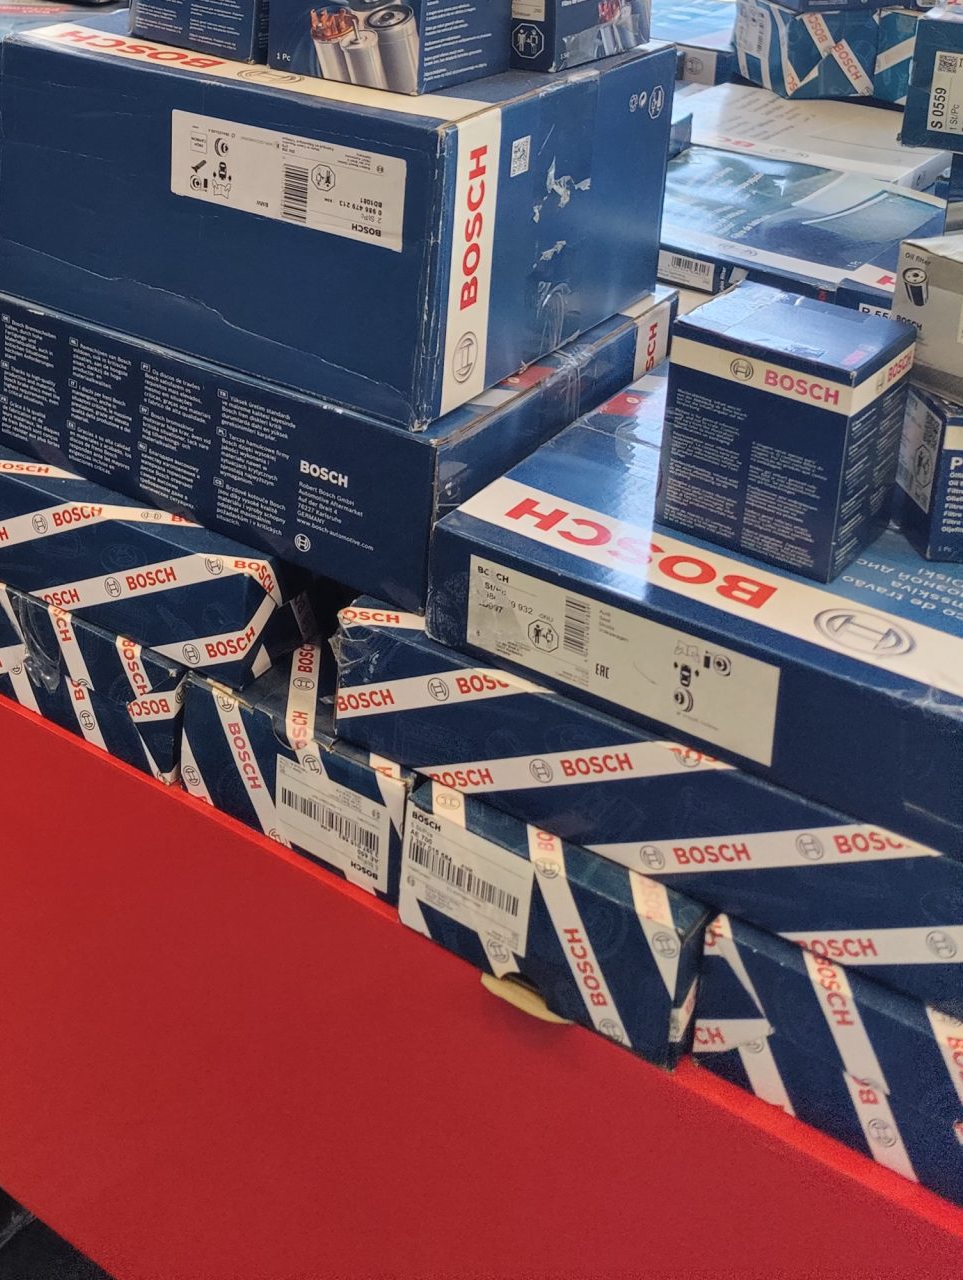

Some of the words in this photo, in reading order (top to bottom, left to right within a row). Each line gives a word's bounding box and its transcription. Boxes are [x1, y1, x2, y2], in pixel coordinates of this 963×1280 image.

[57, 29, 227, 70] BOSCH
[832, 42, 862, 81] BOSCH
[931, 87, 947, 117] 0559
[931, 121, 943, 129] S
[256, 200, 269, 208] BMW
[351, 222, 382, 237] BOSCH
[460, 145, 487, 310] BOSCH
[904, 251, 914, 260] Oil
[915, 254, 931, 266] filter
[887, 353, 913, 383] BOSCH
[765, 369, 840, 406] BOSCH
[300, 459, 349, 488] BOSCH
[298, 481, 318, 493] Robert
[318, 488, 336, 500] Bosch
[336, 495, 355, 507] GmbH
[298, 488, 330, 504] Automotive
[330, 500, 364, 518] Aftermarket
[52, 505, 103, 528] BOSCH
[297, 510, 326, 525] GERMANY
[315, 510, 342, 524] Karlsruhe
[505, 497, 779, 609] BOSCH
[126, 566, 176, 591] BOSCH
[234, 559, 275, 593] BOSCH
[518, 603, 534, 615] 932
[205, 626, 255, 659] BOSCH
[121, 637, 148, 696] BOSCH
[128, 697, 170, 716] BOSCH
[338, 689, 395, 712] BOSCH
[228, 722, 261, 790] BOSCH
[560, 753, 634, 777] BOSCH
[412, 811, 442, 832] BOSCH
[673, 843, 752, 865] BOSCH
[350, 860, 379, 880] BOSCH
[564, 927, 607, 1007] BOSCH
[813, 956, 854, 1027] BOSCH
